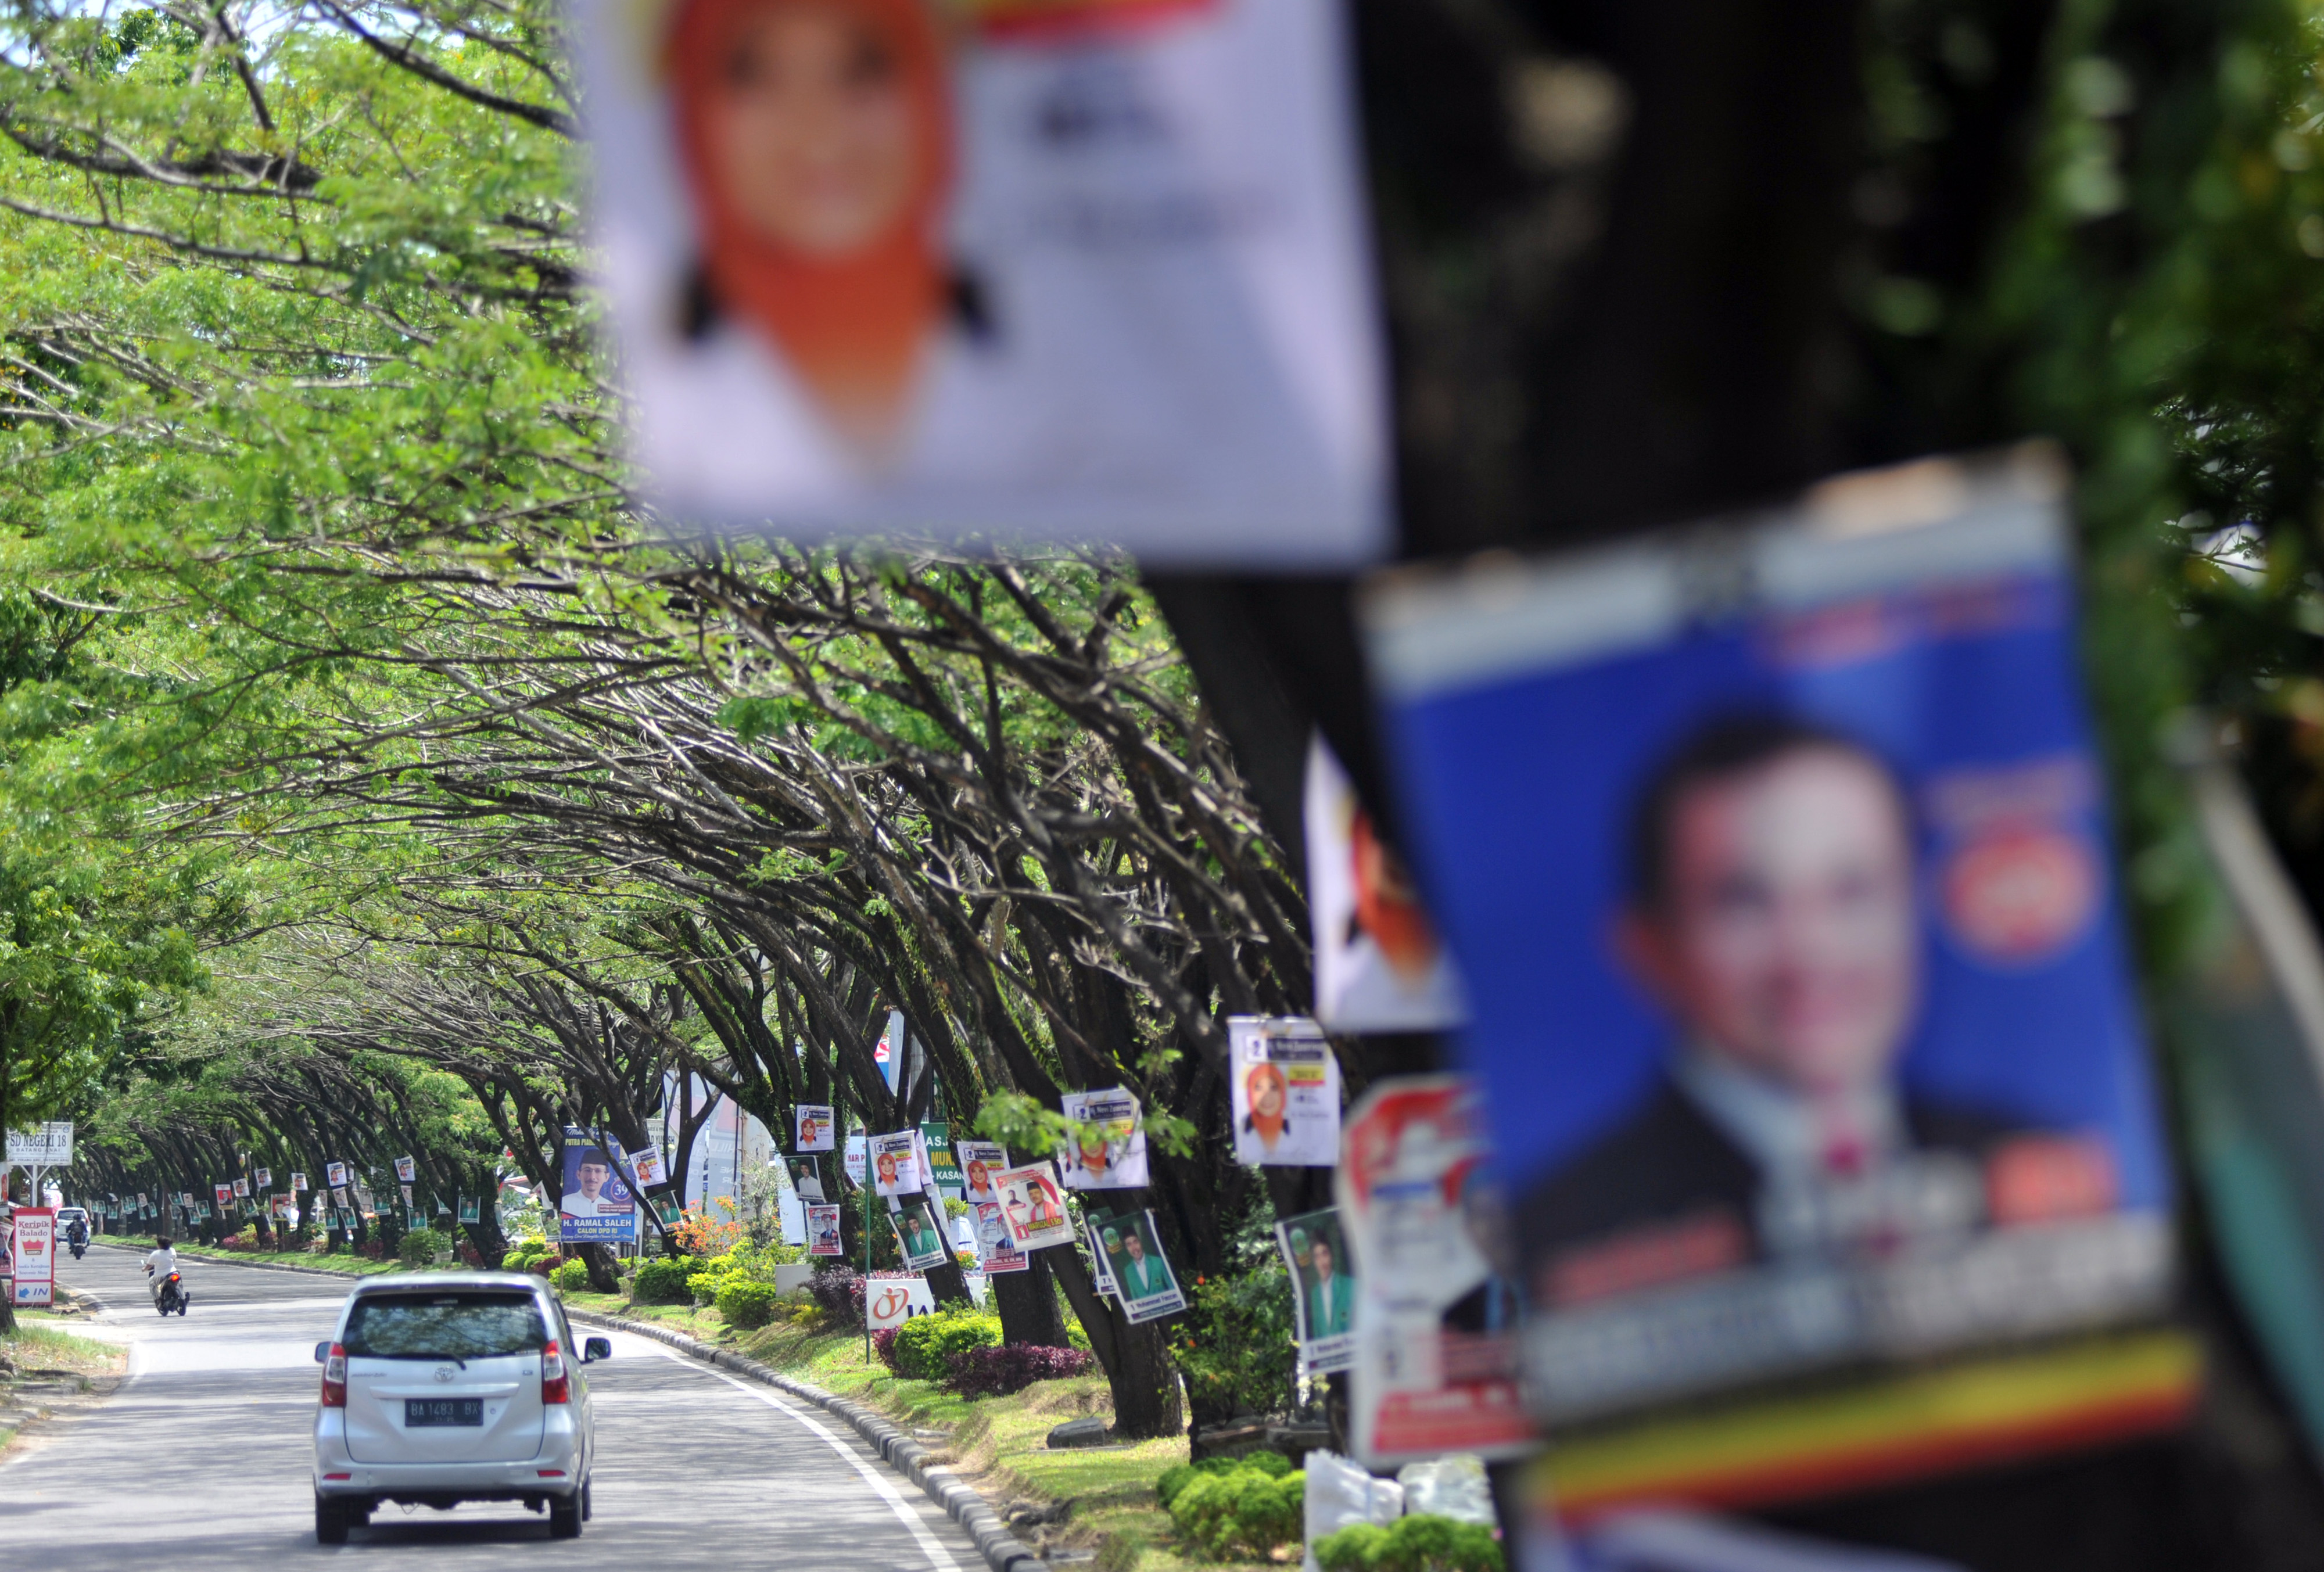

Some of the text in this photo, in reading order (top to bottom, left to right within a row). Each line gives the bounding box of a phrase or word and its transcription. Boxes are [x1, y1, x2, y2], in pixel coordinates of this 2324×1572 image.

[1080, 1108, 1086, 1119] 2
[10, 1135, 66, 1147] SD NEGERI 18
[931, 1152, 955, 1166] MUK
[614, 1185, 627, 1196] 39
[1018, 1227, 1027, 1239] 1
[411, 1404, 424, 1416] BA
